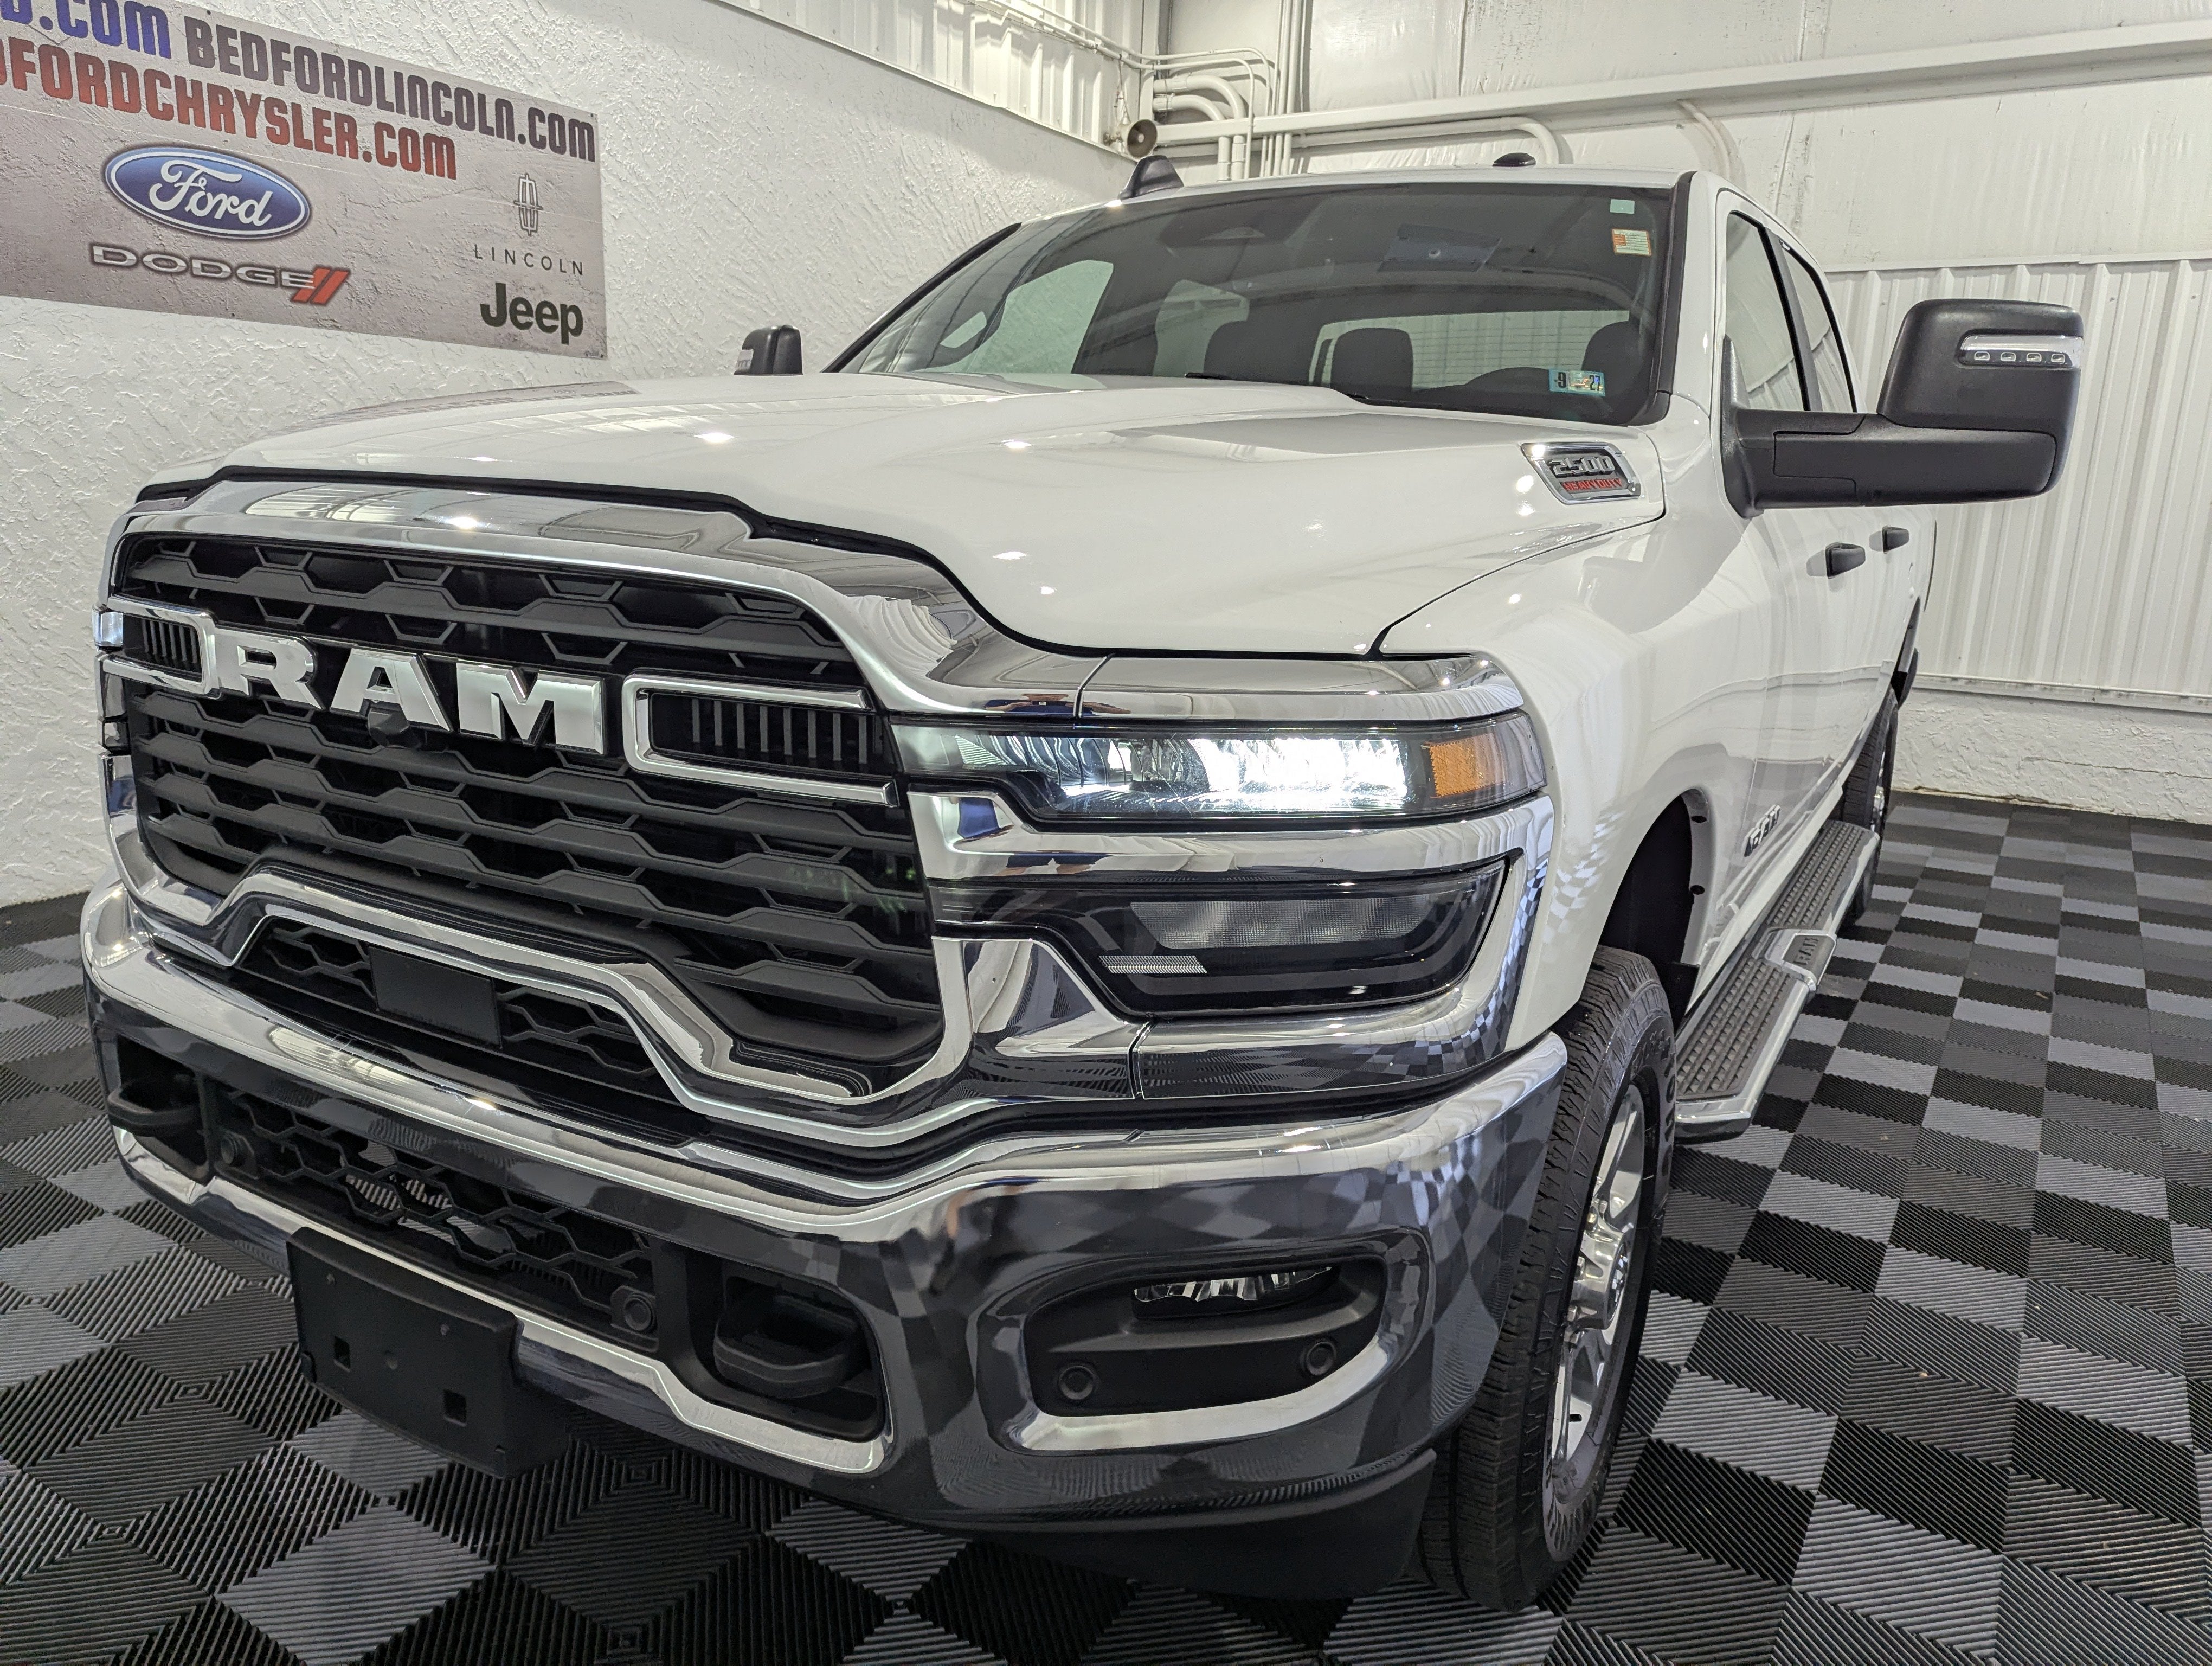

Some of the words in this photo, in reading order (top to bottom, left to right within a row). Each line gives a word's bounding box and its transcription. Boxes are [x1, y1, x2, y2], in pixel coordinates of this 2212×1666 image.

[0, 36, 456, 180] FORDCHRYSLER.COM
[184, 16, 595, 162] BEDFORDLINCOLN.COM
[149, 160, 273, 226] Ford
[93, 246, 315, 290] DODGE
[474, 244, 583, 275] LINCOLN
[480, 282, 583, 345] Jeep
[1589, 375, 1600, 391] 27
[1547, 454, 1616, 478] 2500
[1561, 480, 1596, 491] HEAVY
[1594, 478, 1623, 489] DUTY
[213, 626, 608, 755] RAM
